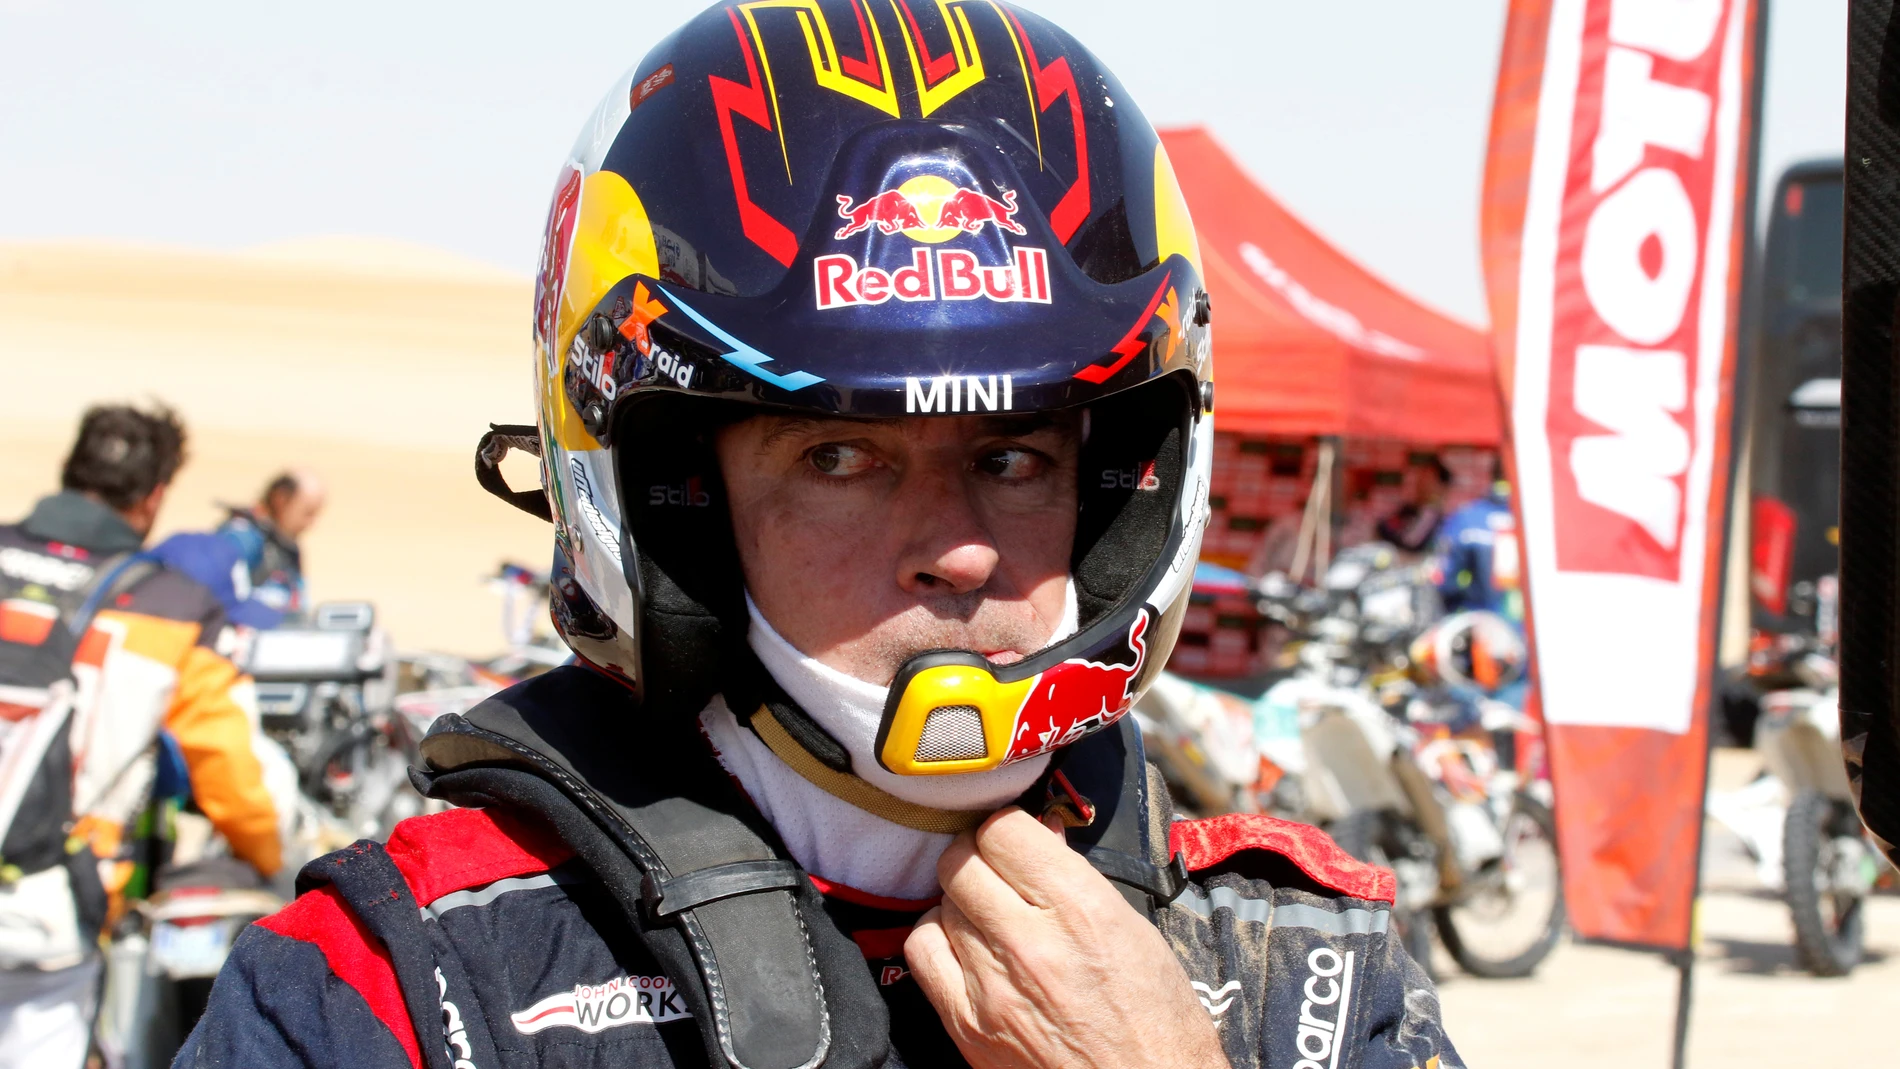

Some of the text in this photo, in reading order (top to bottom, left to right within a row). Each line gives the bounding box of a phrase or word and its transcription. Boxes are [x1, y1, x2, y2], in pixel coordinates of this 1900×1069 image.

[814, 246, 1052, 310] Red Bull
[569, 334, 617, 401] Stilo
[905, 374, 1013, 414] MINI
[648, 477, 711, 508] Stilo
[1101, 458, 1161, 492] Stilo
[574, 979, 620, 1000] JOHN
[575, 991, 692, 1028] WORK
